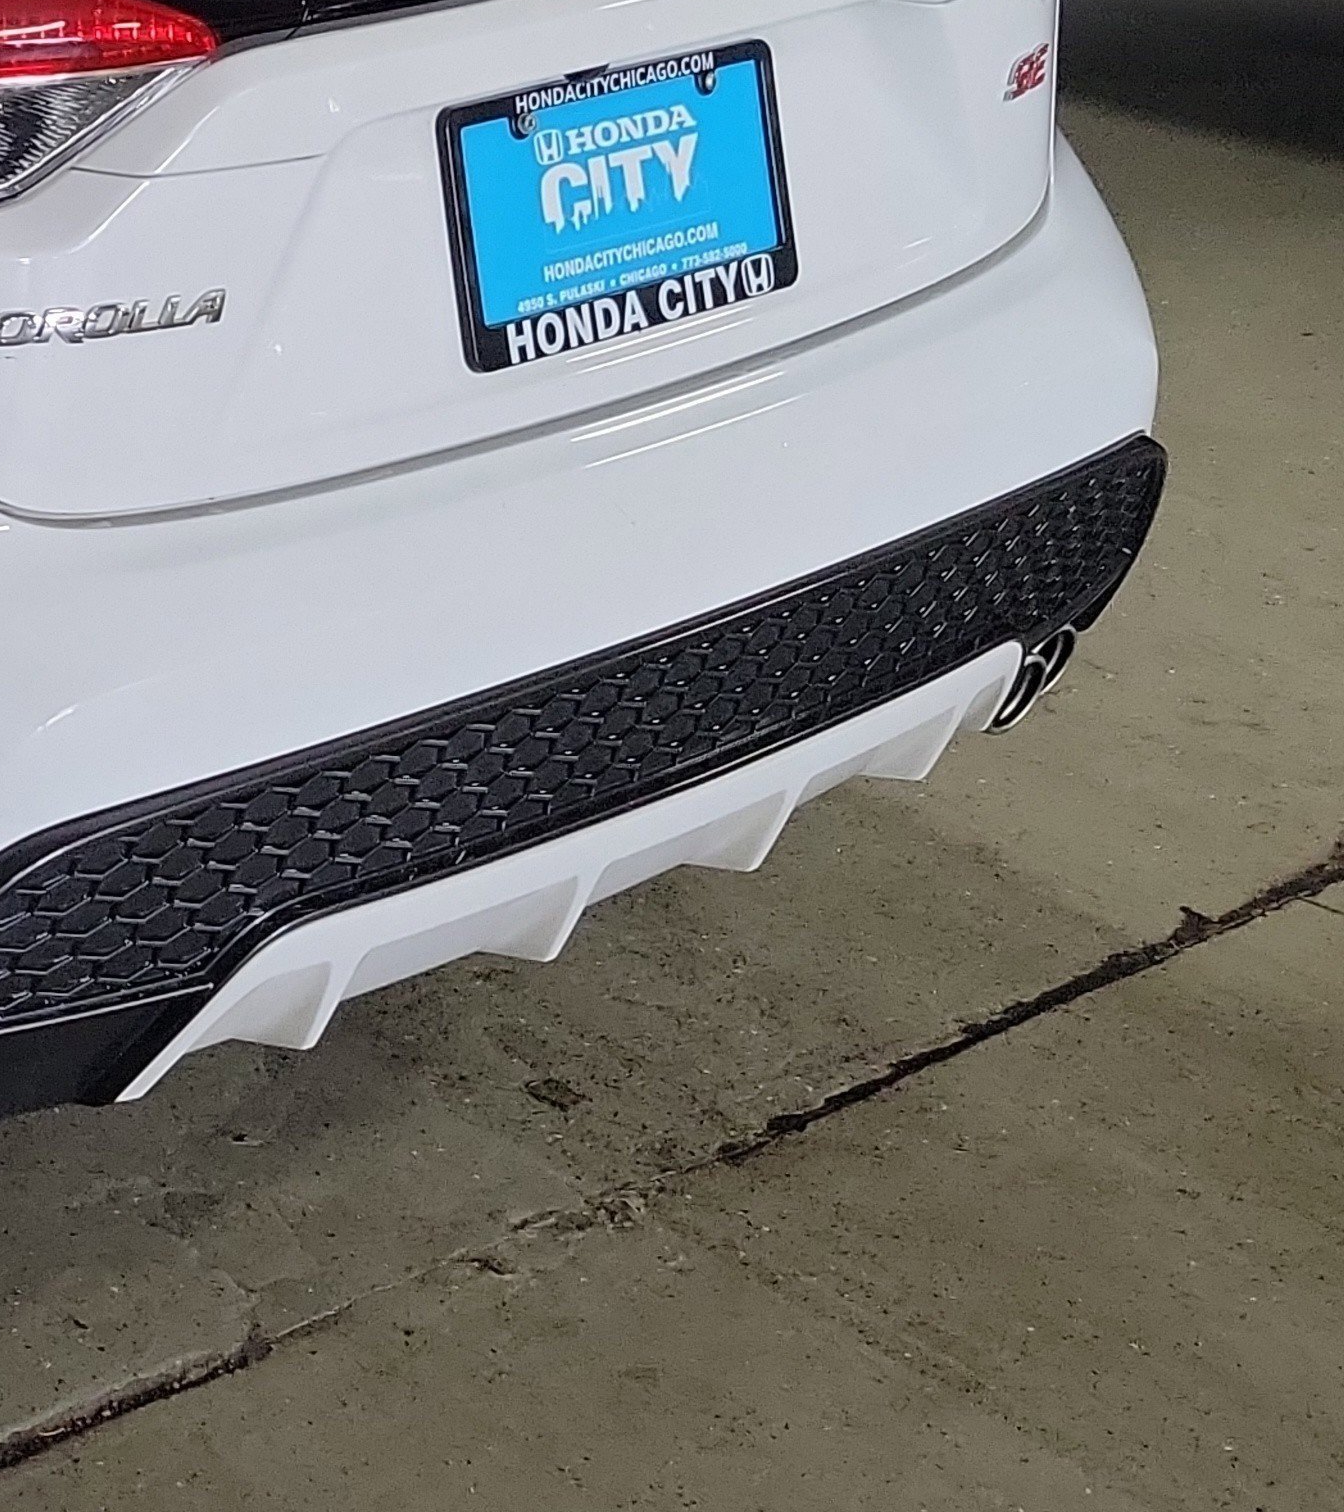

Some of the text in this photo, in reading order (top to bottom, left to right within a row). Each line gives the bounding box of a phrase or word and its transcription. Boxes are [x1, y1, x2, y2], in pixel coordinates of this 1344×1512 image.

[515, 51, 714, 114] HONDACITYCHICAGO.COM
[565, 104, 698, 155] HONDA
[541, 132, 699, 235] CITY
[543, 222, 718, 283] HONDACITYCHICAGO.COM
[559, 279, 606, 303] PULASKI
[619, 263, 667, 286] CHICAGO
[506, 290, 649, 364] HONDA
[658, 260, 739, 321] CITY
